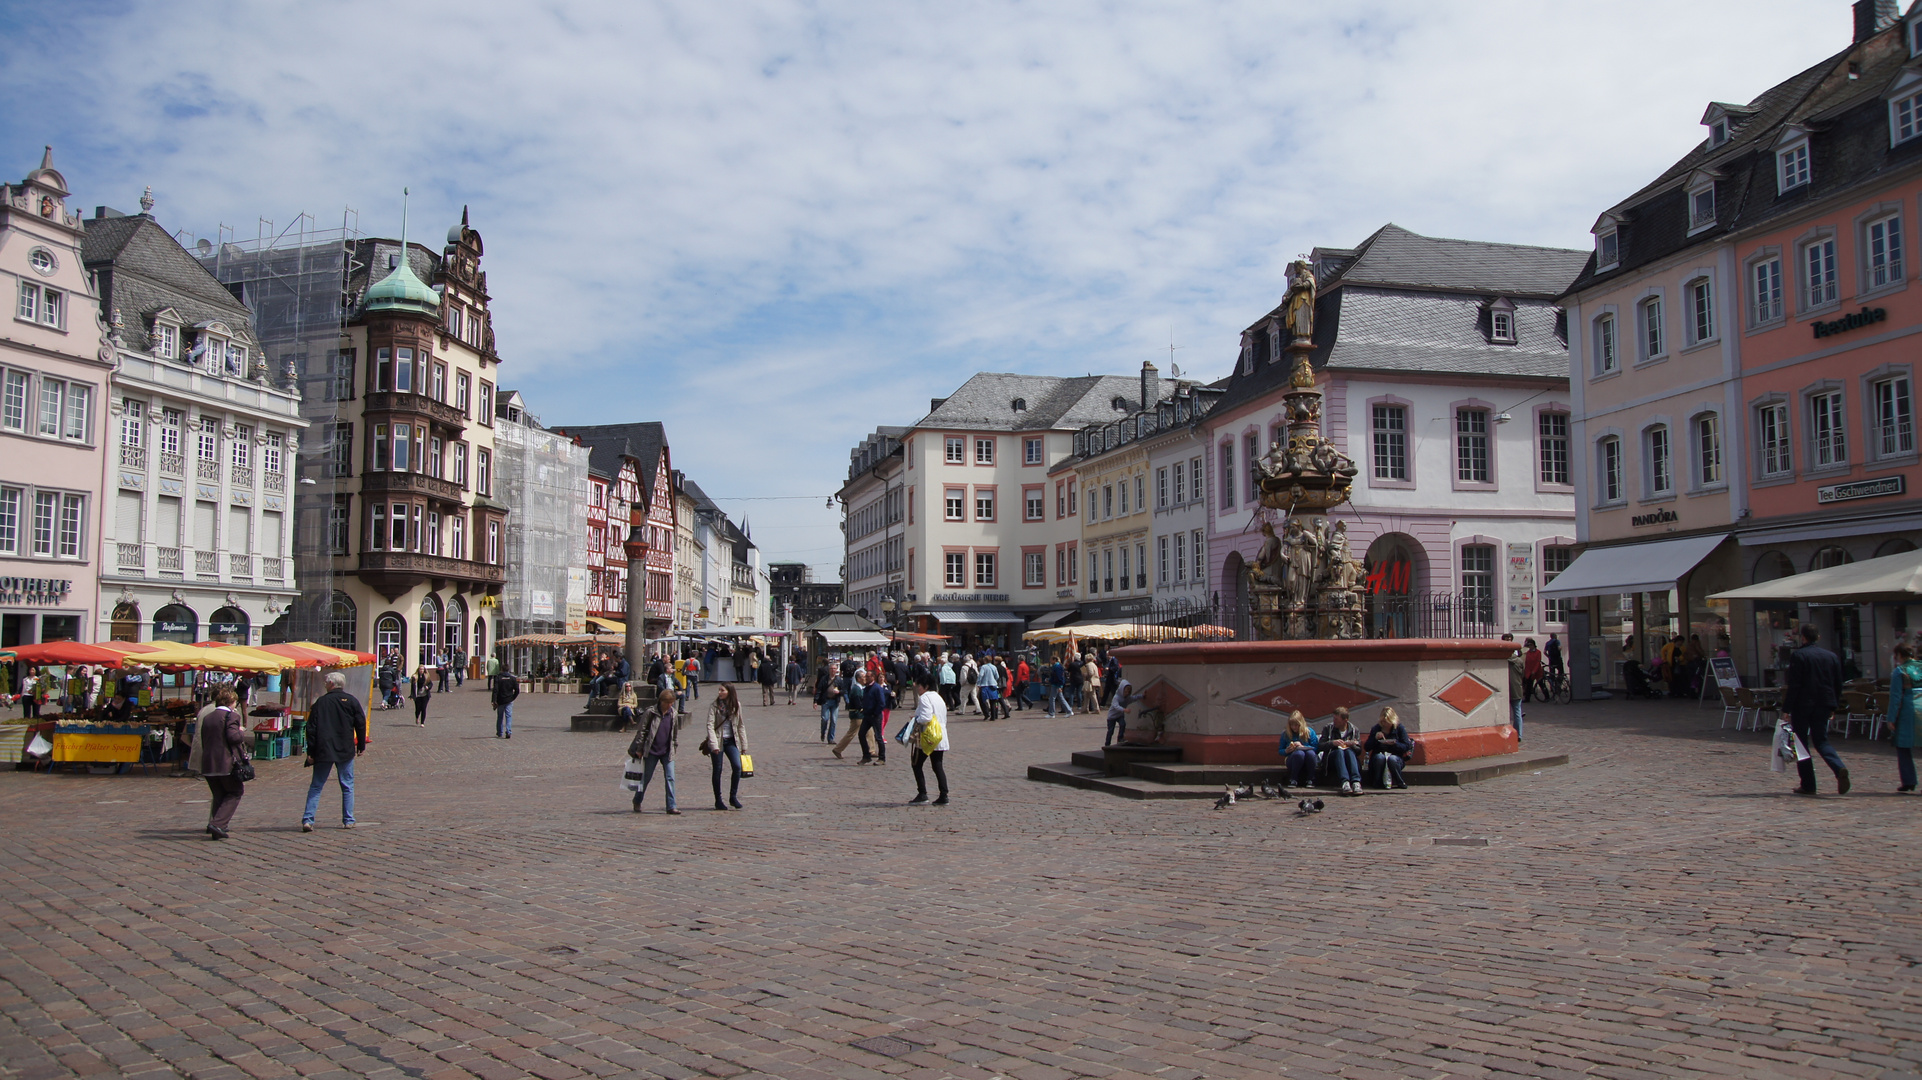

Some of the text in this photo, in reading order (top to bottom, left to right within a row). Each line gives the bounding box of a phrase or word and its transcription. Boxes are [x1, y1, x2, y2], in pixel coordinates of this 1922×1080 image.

[1810, 306, 1887, 339] Teestube
[1819, 481, 1897, 501] Tee Gschwendner
[1632, 509, 1678, 526] PANDORA
[1366, 560, 1412, 595] H&M
[934, 592, 1010, 602] PARFÜMERIE PIERRE
[84, 743, 110, 753] Pfälzer
[112, 743, 139, 753] Spargel
